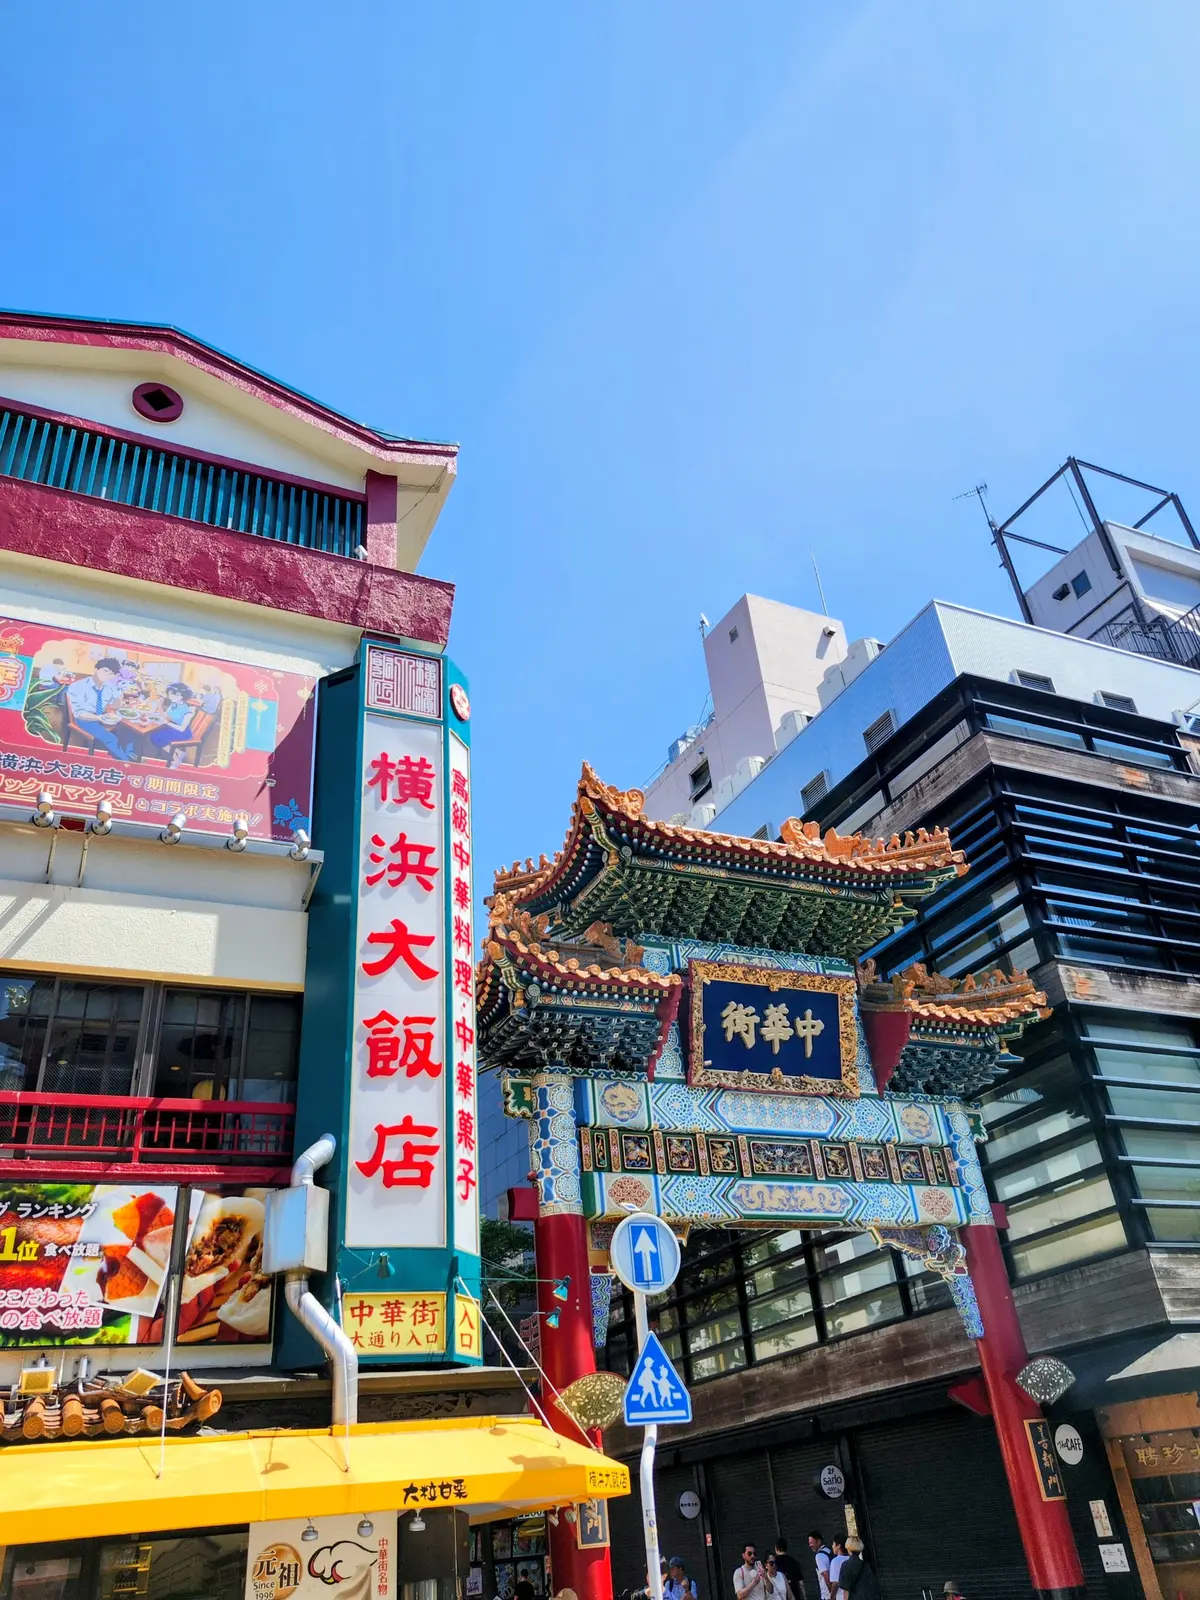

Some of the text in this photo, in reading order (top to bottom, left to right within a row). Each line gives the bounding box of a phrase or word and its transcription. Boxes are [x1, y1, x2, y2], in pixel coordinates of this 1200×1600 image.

[355, 752, 443, 1188] 横浜大飯店
[17, 1203, 98, 1219] ランキング
[0, 1226, 101, 1262] 1位 食べ放題
[350, 1299, 440, 1327] 中華街
[458, 1303, 475, 1350] 入口
[350, 1330, 438, 1349] 大通り入口
[1065, 1438, 1083, 1451] CAFE
[403, 1478, 468, 1504] 大粒甘栗
[253, 1550, 300, 1588] 元祖
[377, 1538, 388, 1596] 中華街名物
[253, 1580, 275, 1591] Since
[255, 1590, 274, 1600] 1996
